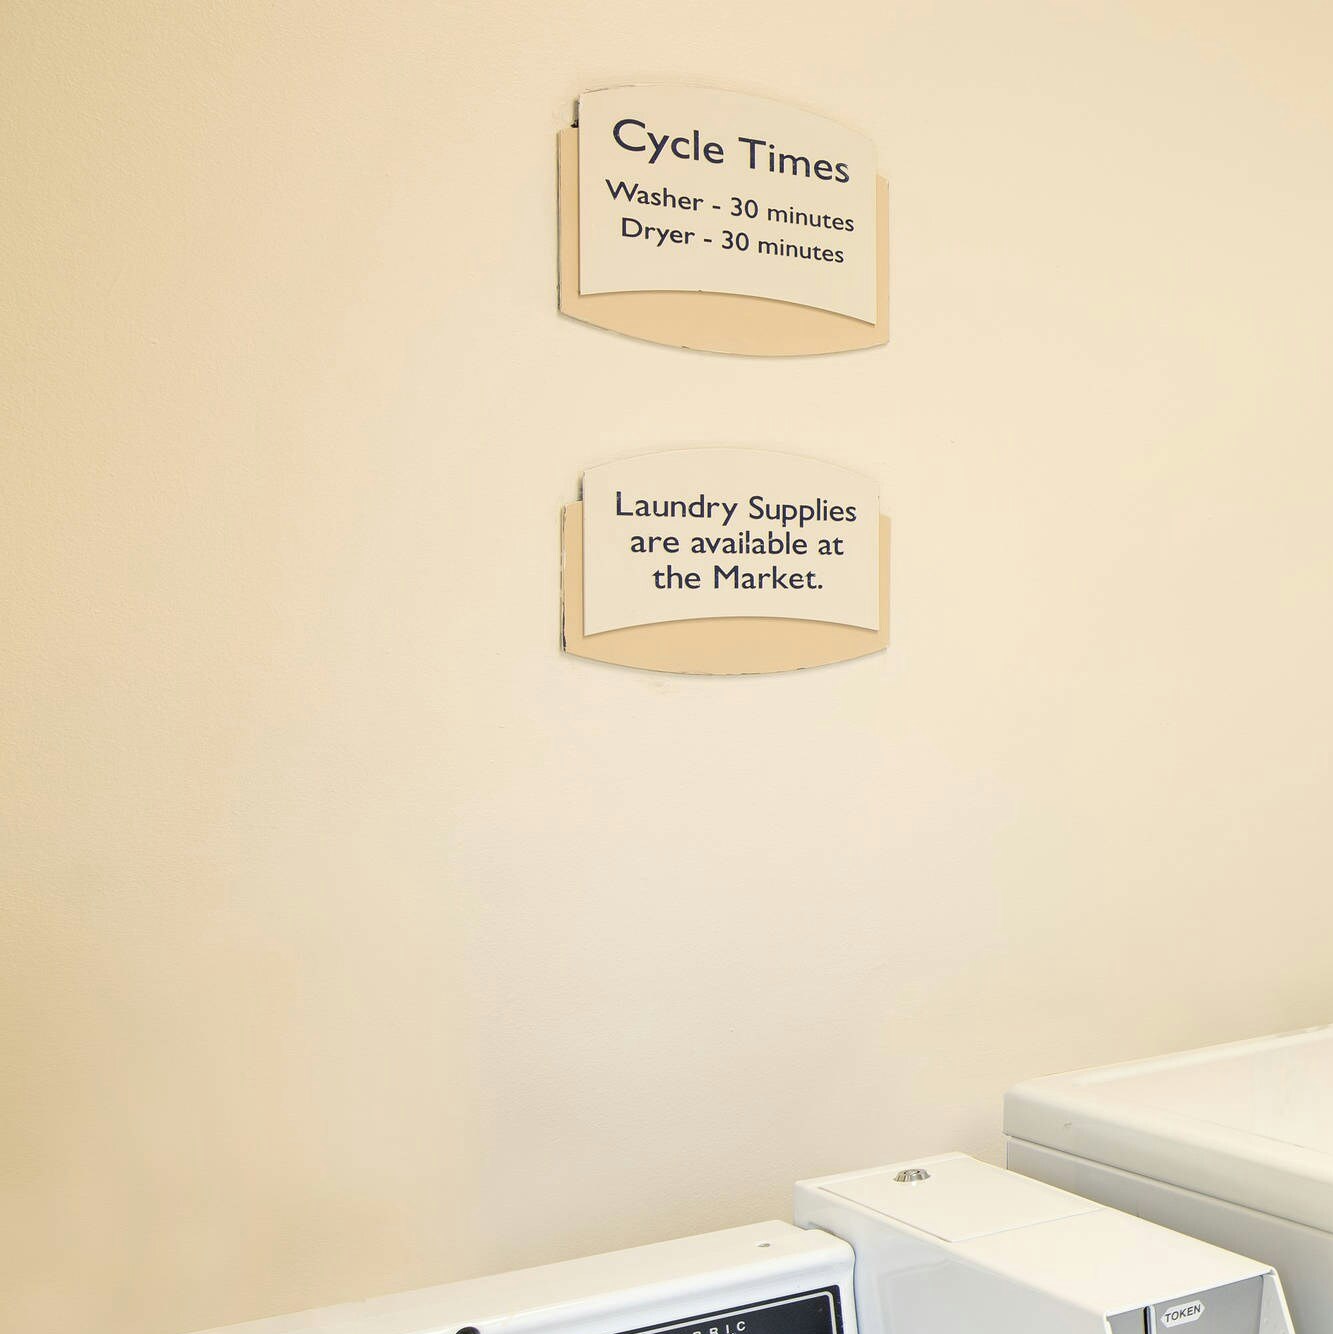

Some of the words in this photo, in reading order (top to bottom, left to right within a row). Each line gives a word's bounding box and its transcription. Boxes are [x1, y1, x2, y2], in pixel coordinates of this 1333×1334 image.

[613, 118, 724, 164] Cycle
[738, 136, 850, 184] Times
[605, 179, 704, 211] Washer
[730, 197, 759, 219] 30
[767, 206, 855, 232] minutes
[621, 217, 695, 247] Dryer
[721, 231, 750, 251] 30
[758, 239, 845, 264] minutes
[616, 491, 738, 526] Laundry
[749, 496, 857, 528] Supplies
[630, 535, 680, 553] are
[691, 531, 808, 555] available
[818, 537, 844, 555] at
[653, 565, 701, 589] the
[713, 565, 823, 590] Market.
[1165, 1304, 1201, 1323] TOKEN
